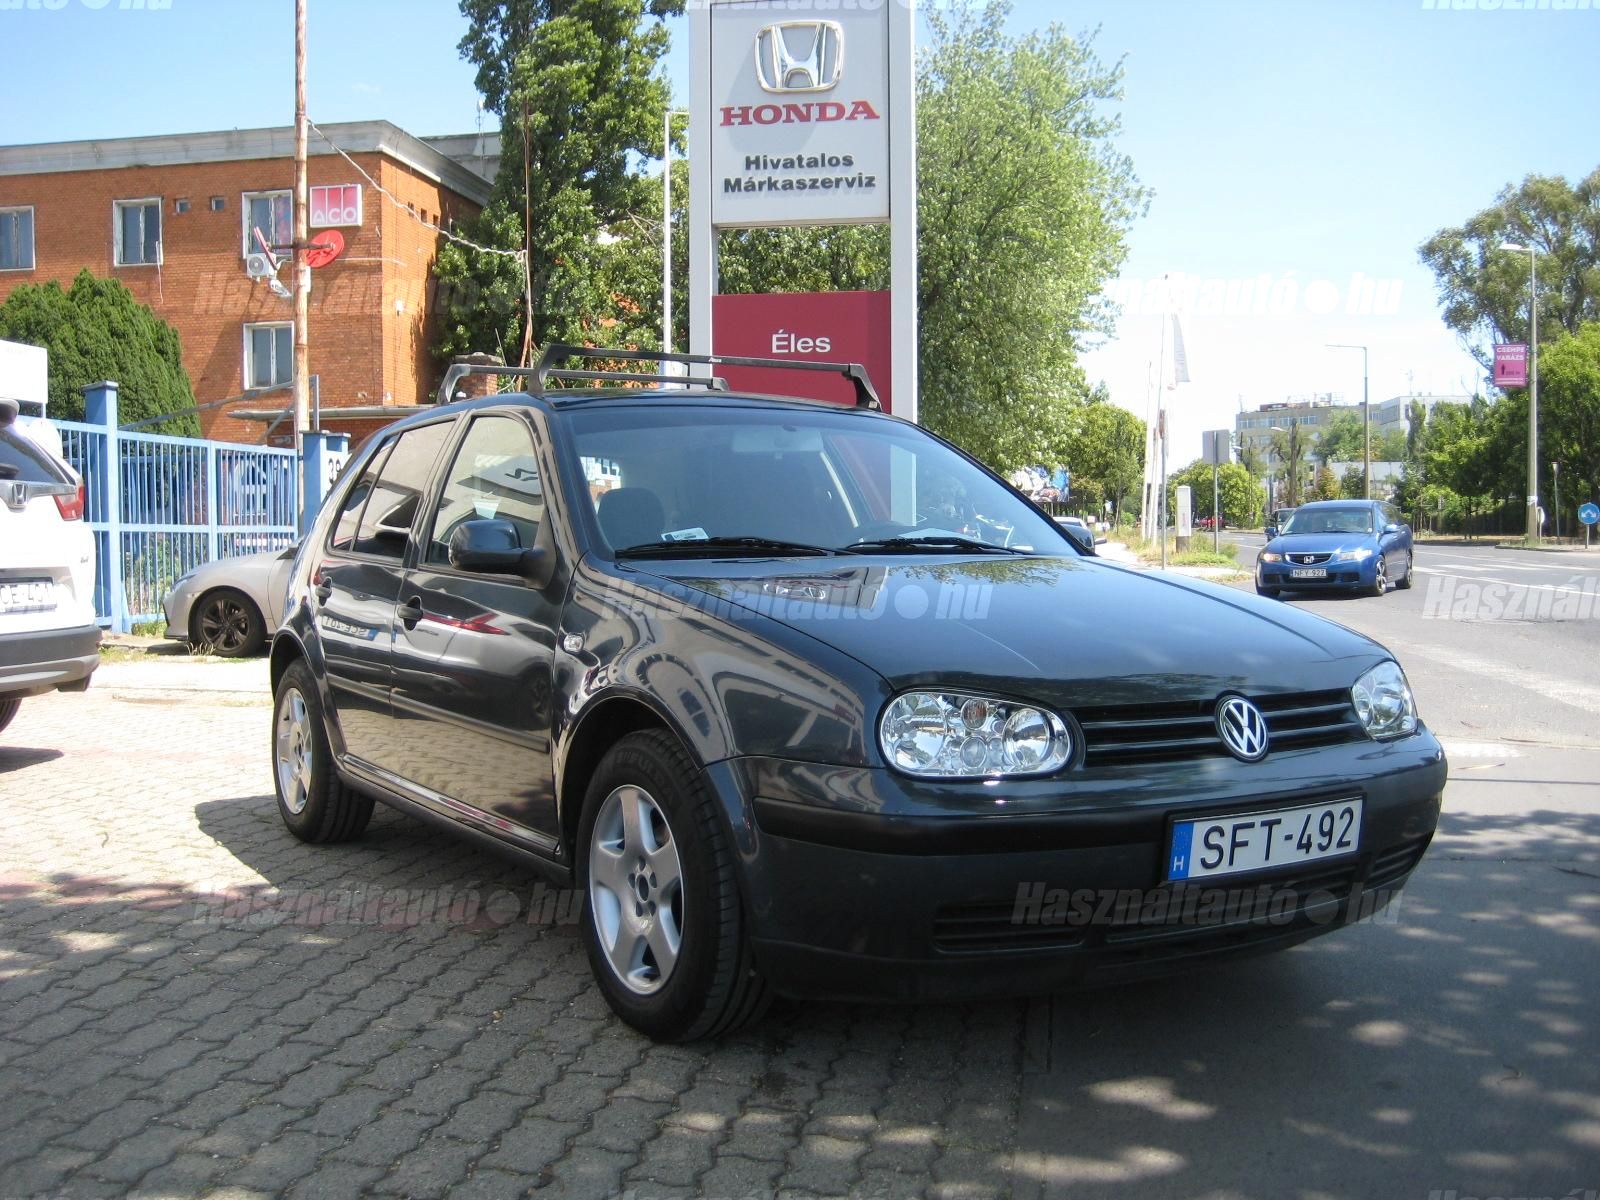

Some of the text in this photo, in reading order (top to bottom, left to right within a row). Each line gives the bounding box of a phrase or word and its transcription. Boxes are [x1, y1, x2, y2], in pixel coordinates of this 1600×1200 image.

[720, 100, 880, 126] HONDA
[745, 153, 854, 171] Hivatalos
[724, 173, 876, 193] Márkaszerviz
[313, 207, 357, 224] ACO
[772, 329, 831, 353] Éles
[1200, 807, 1354, 869] SFT-492
[1173, 855, 1184, 872] H
